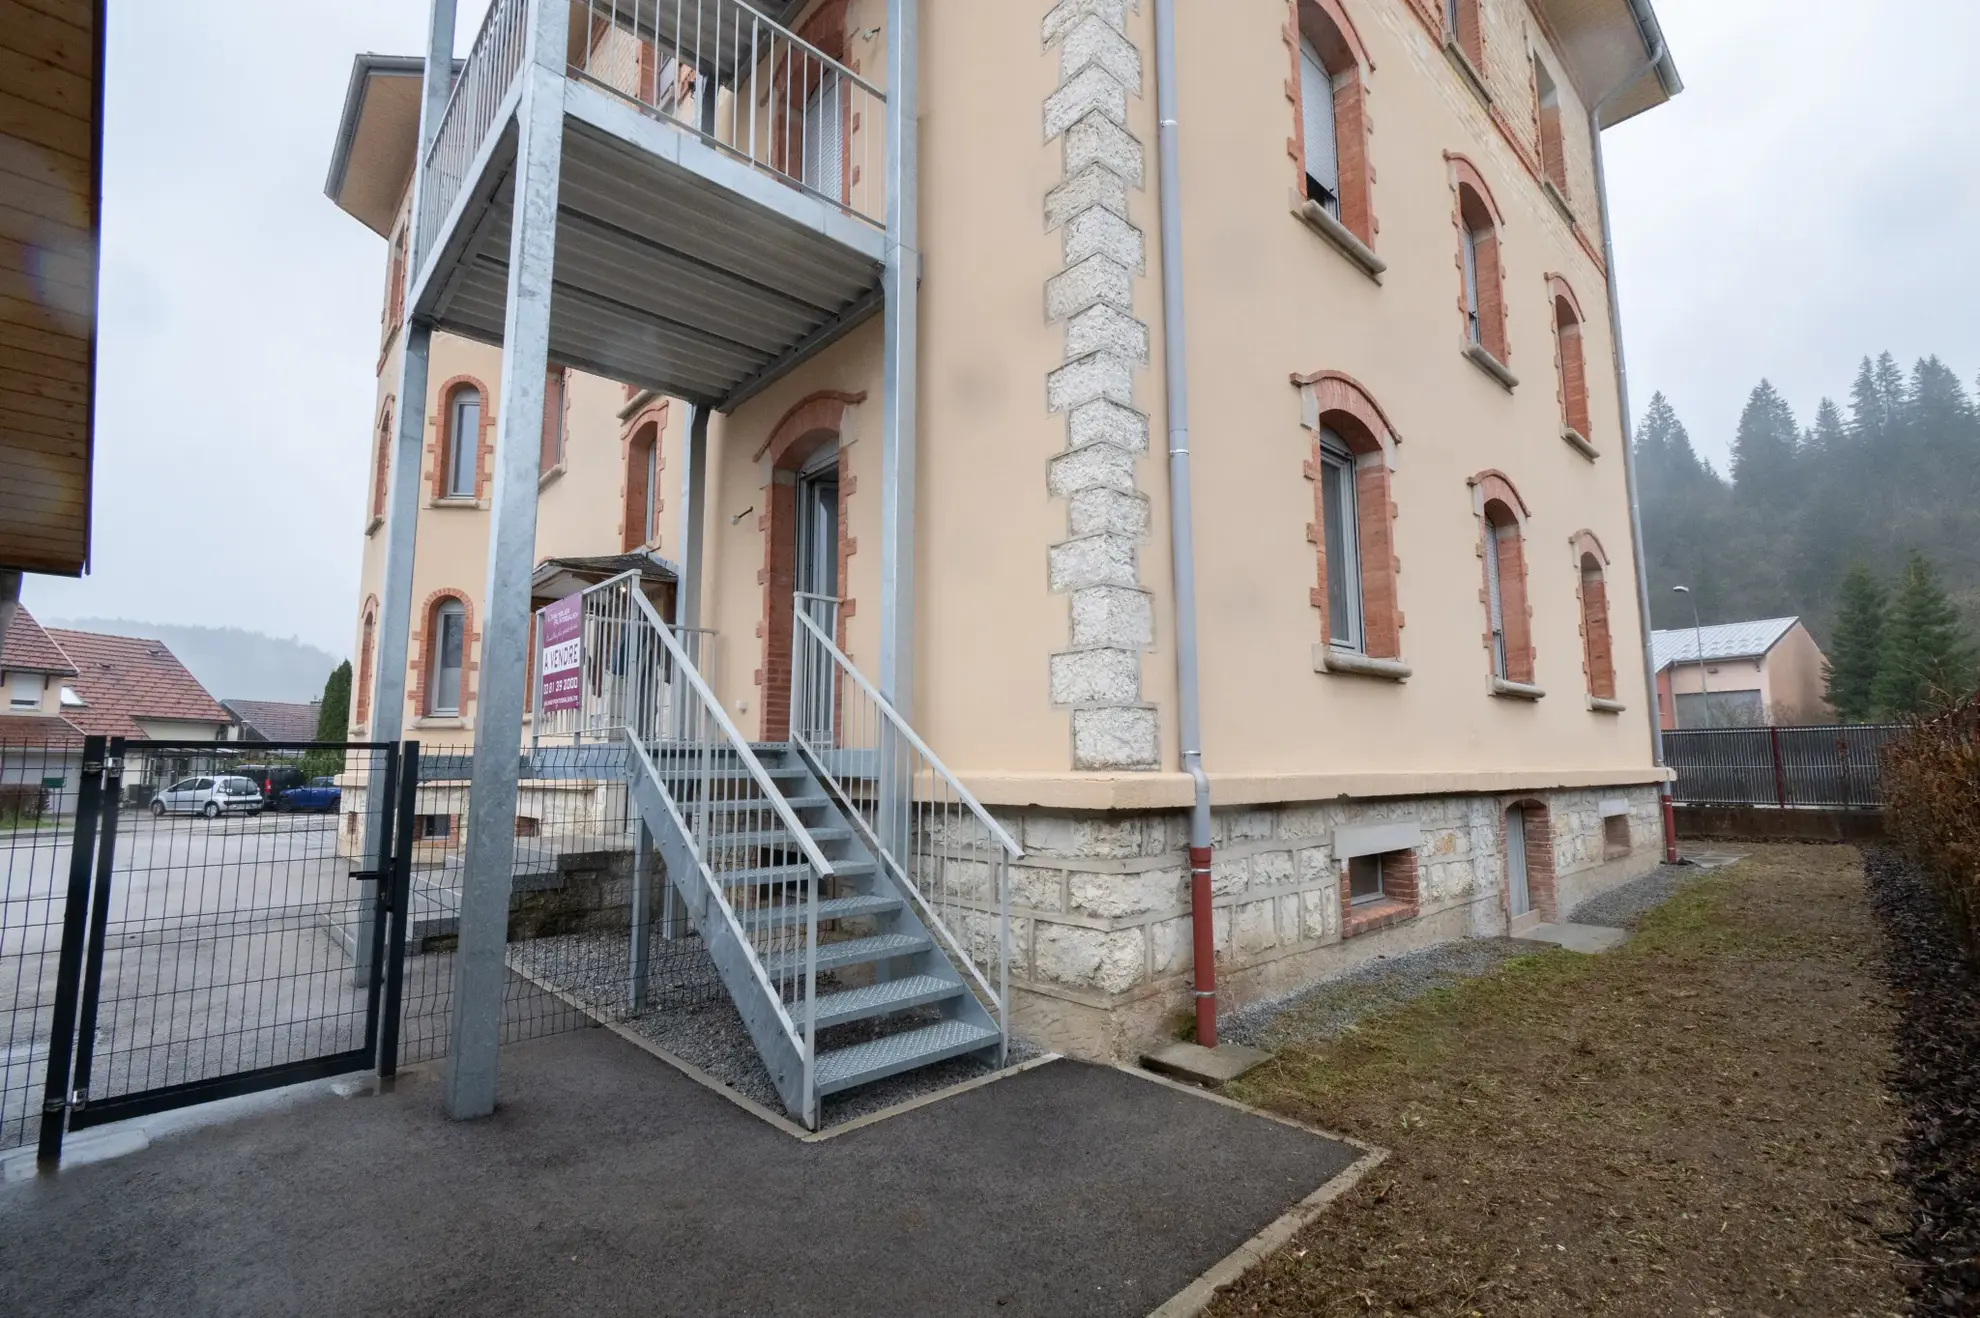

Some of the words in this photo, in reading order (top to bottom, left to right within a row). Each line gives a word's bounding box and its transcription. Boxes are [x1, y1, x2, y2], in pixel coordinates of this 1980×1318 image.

[544, 653, 549, 671] A
[550, 643, 578, 669] VENDRE
[555, 679, 563, 692] 39
